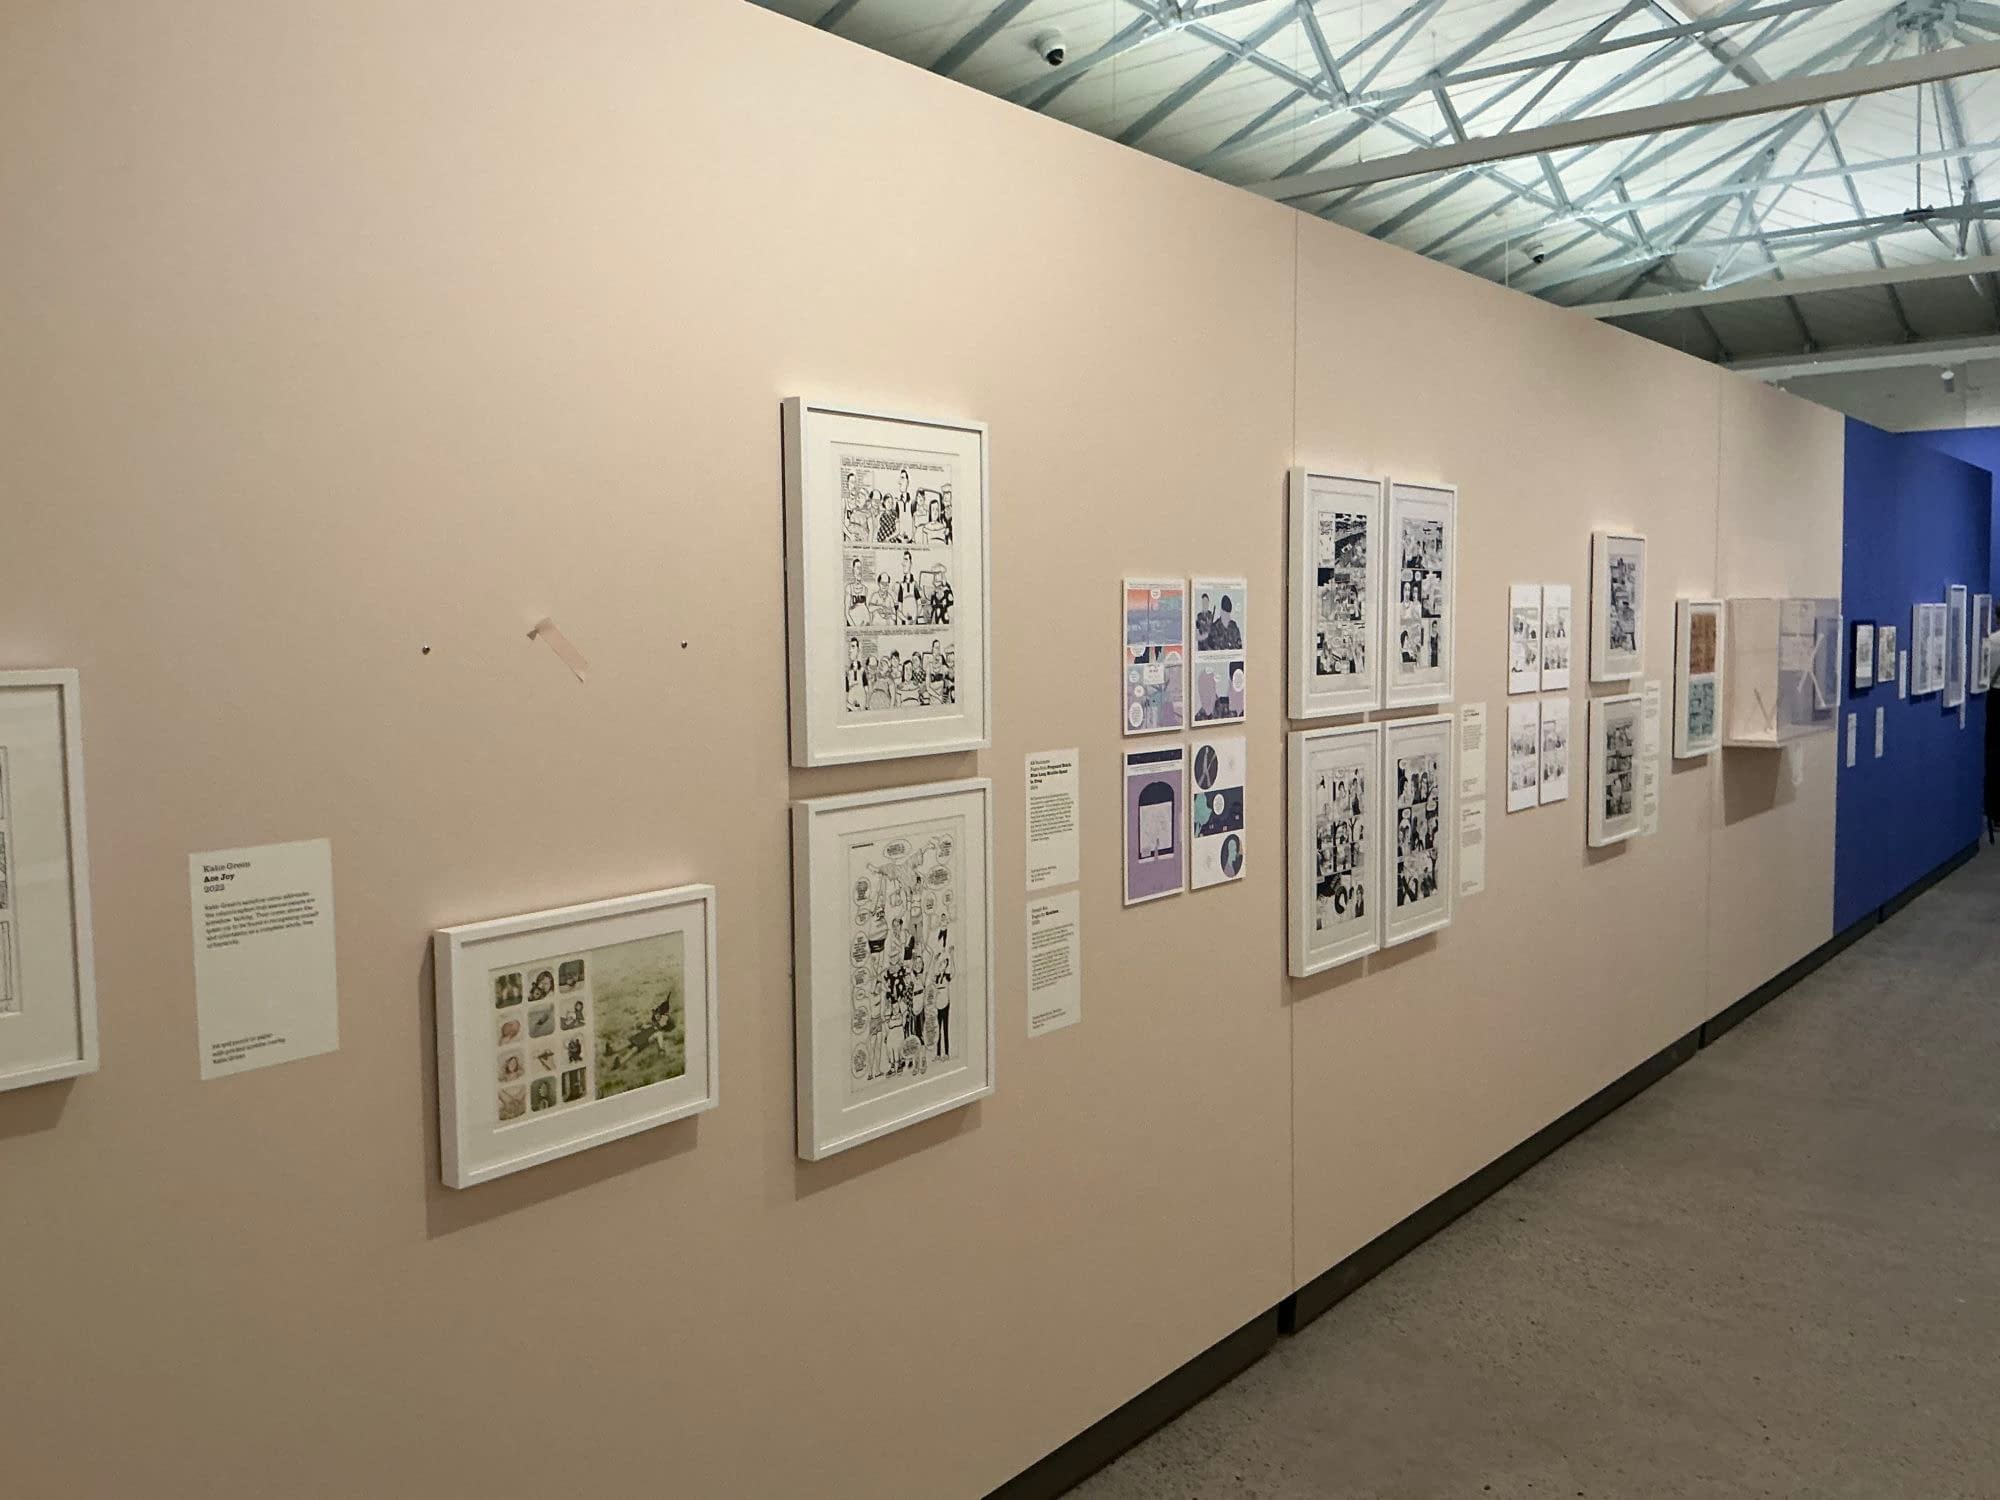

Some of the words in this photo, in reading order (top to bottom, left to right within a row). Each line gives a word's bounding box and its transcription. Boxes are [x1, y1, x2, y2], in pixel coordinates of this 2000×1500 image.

[226, 861, 251, 870] Green
[220, 873, 235, 881] Joy
[203, 884, 225, 893] 2022
